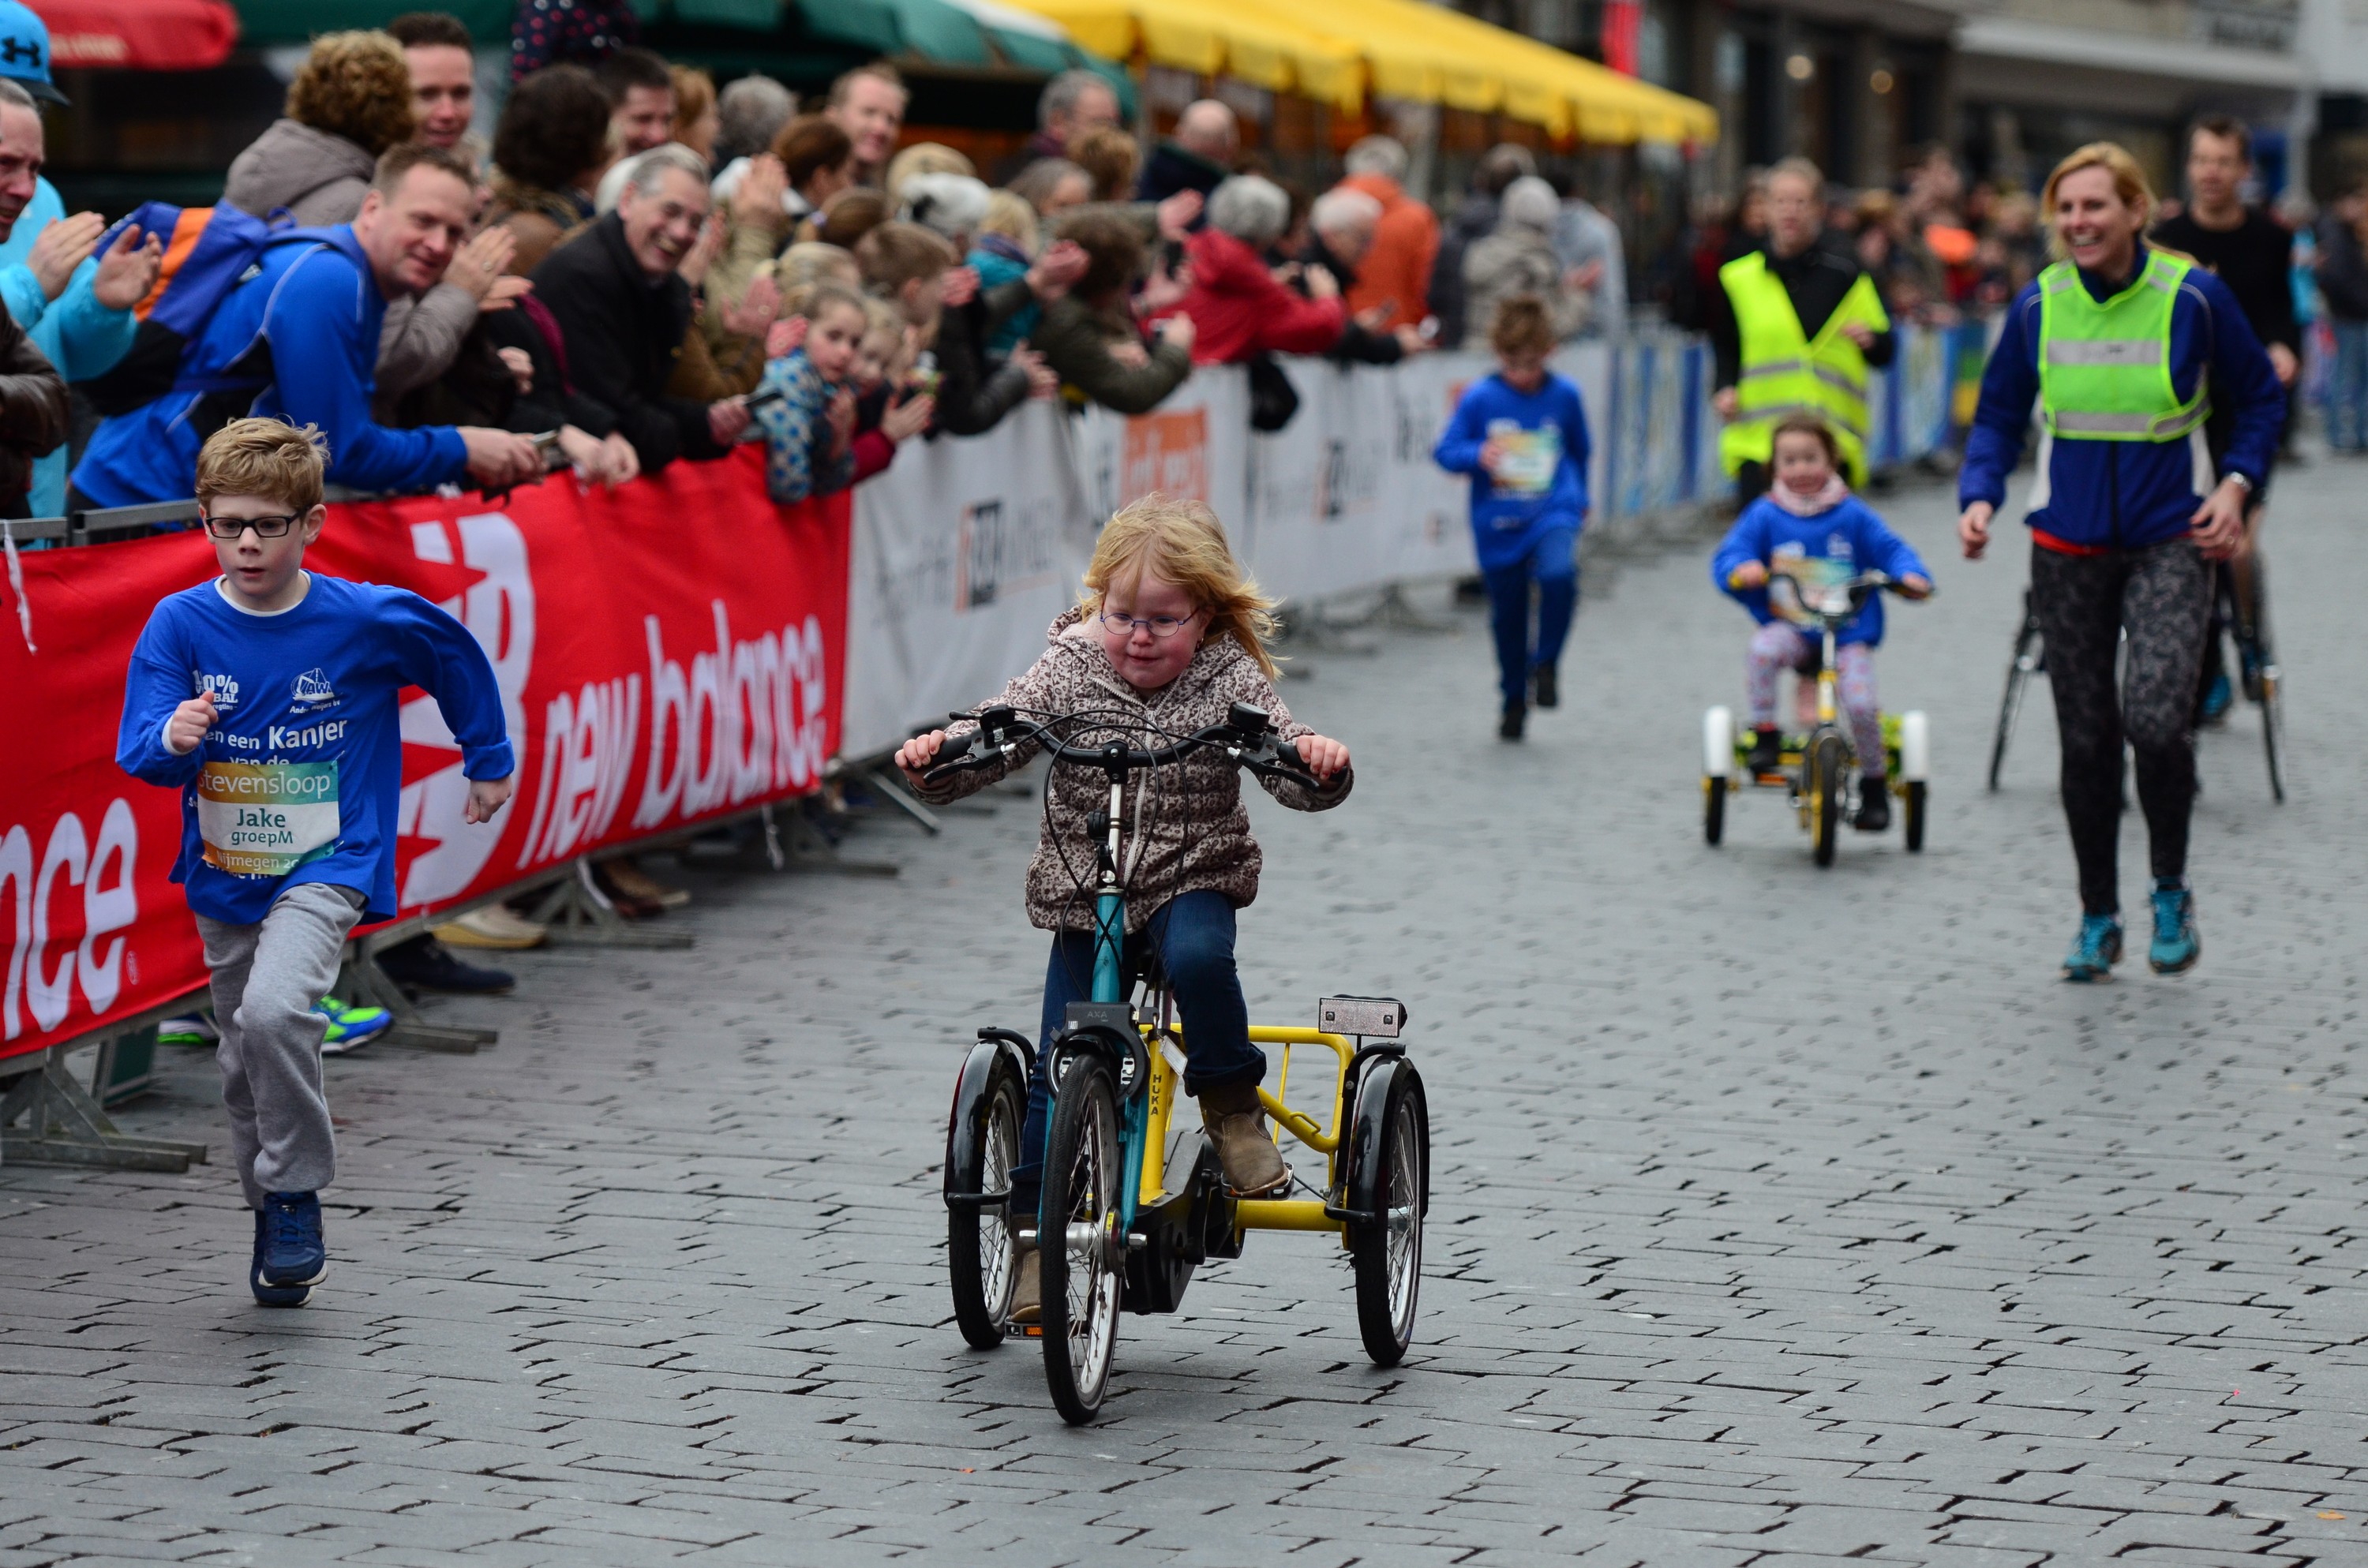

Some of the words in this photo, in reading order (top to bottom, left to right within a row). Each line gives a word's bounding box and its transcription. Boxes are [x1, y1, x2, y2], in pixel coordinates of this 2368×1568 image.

[205, 730, 224, 743] en
[227, 735, 260, 750] een
[268, 720, 347, 750] Kanjer
[516, 671, 642, 869] new
[631, 598, 826, 830] balance
[237, 808, 287, 827] Jake
[231, 830, 294, 847] groepM
[217, 850, 279, 871] Nijmegen
[1087, 1010, 1108, 1019] AXA
[1151, 1074, 1163, 1116] HUKA
